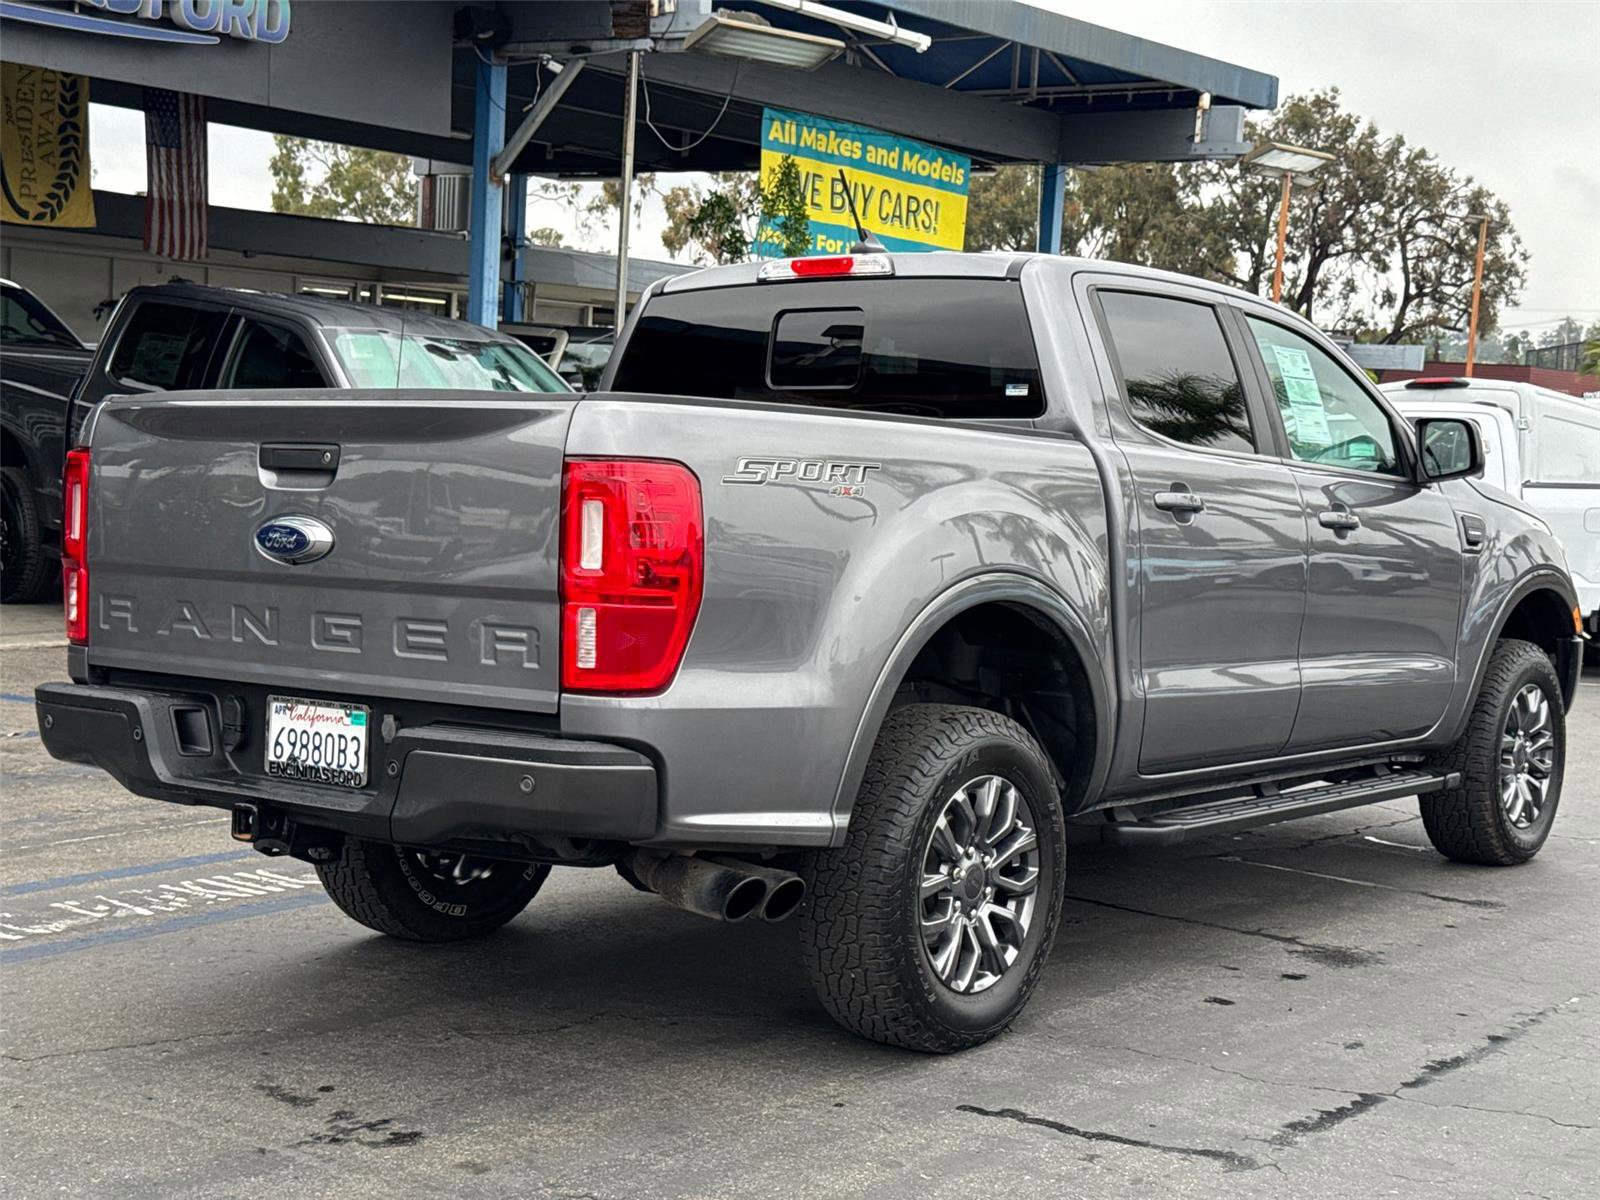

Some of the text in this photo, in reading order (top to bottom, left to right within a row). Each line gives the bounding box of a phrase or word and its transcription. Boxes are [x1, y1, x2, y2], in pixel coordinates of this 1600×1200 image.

[768, 120, 965, 186] All Makes and Models
[830, 177, 875, 221] BUY
[878, 188, 941, 236] CARS!
[816, 234, 843, 254] For
[721, 456, 882, 486] SPORT
[264, 527, 299, 550] Ford
[98, 592, 542, 670] RANGER
[274, 704, 287, 716] APR
[290, 705, 350, 727] California
[274, 726, 361, 770] 69880B3
[268, 761, 363, 787] ENCINITAS FORD
